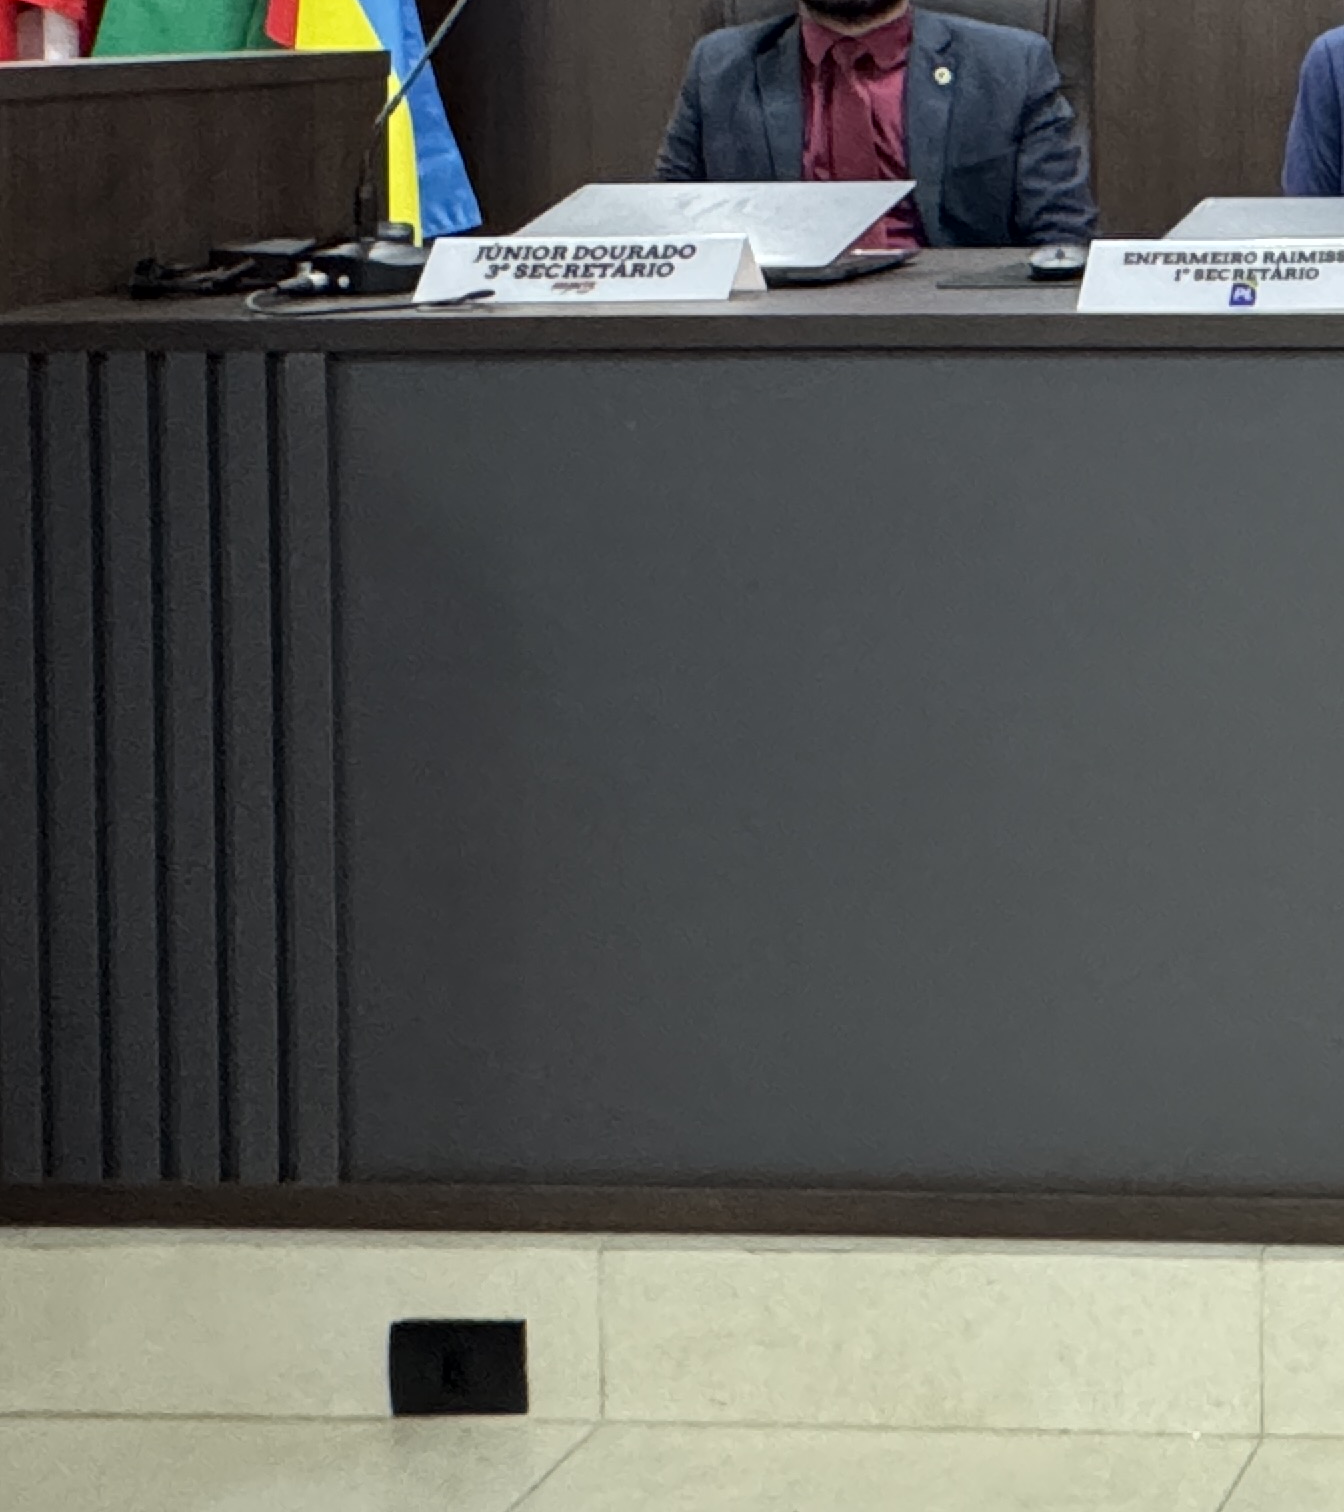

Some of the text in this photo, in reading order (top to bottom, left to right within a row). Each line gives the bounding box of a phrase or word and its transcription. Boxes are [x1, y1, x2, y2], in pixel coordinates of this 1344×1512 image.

[473, 243, 698, 263] JÚNIOR DOURADO
[1123, 250, 1258, 266] ENFERMEIRO
[512, 259, 676, 279] SECRETÁRIO
[1193, 261, 1320, 281] SECRETÁRIO
